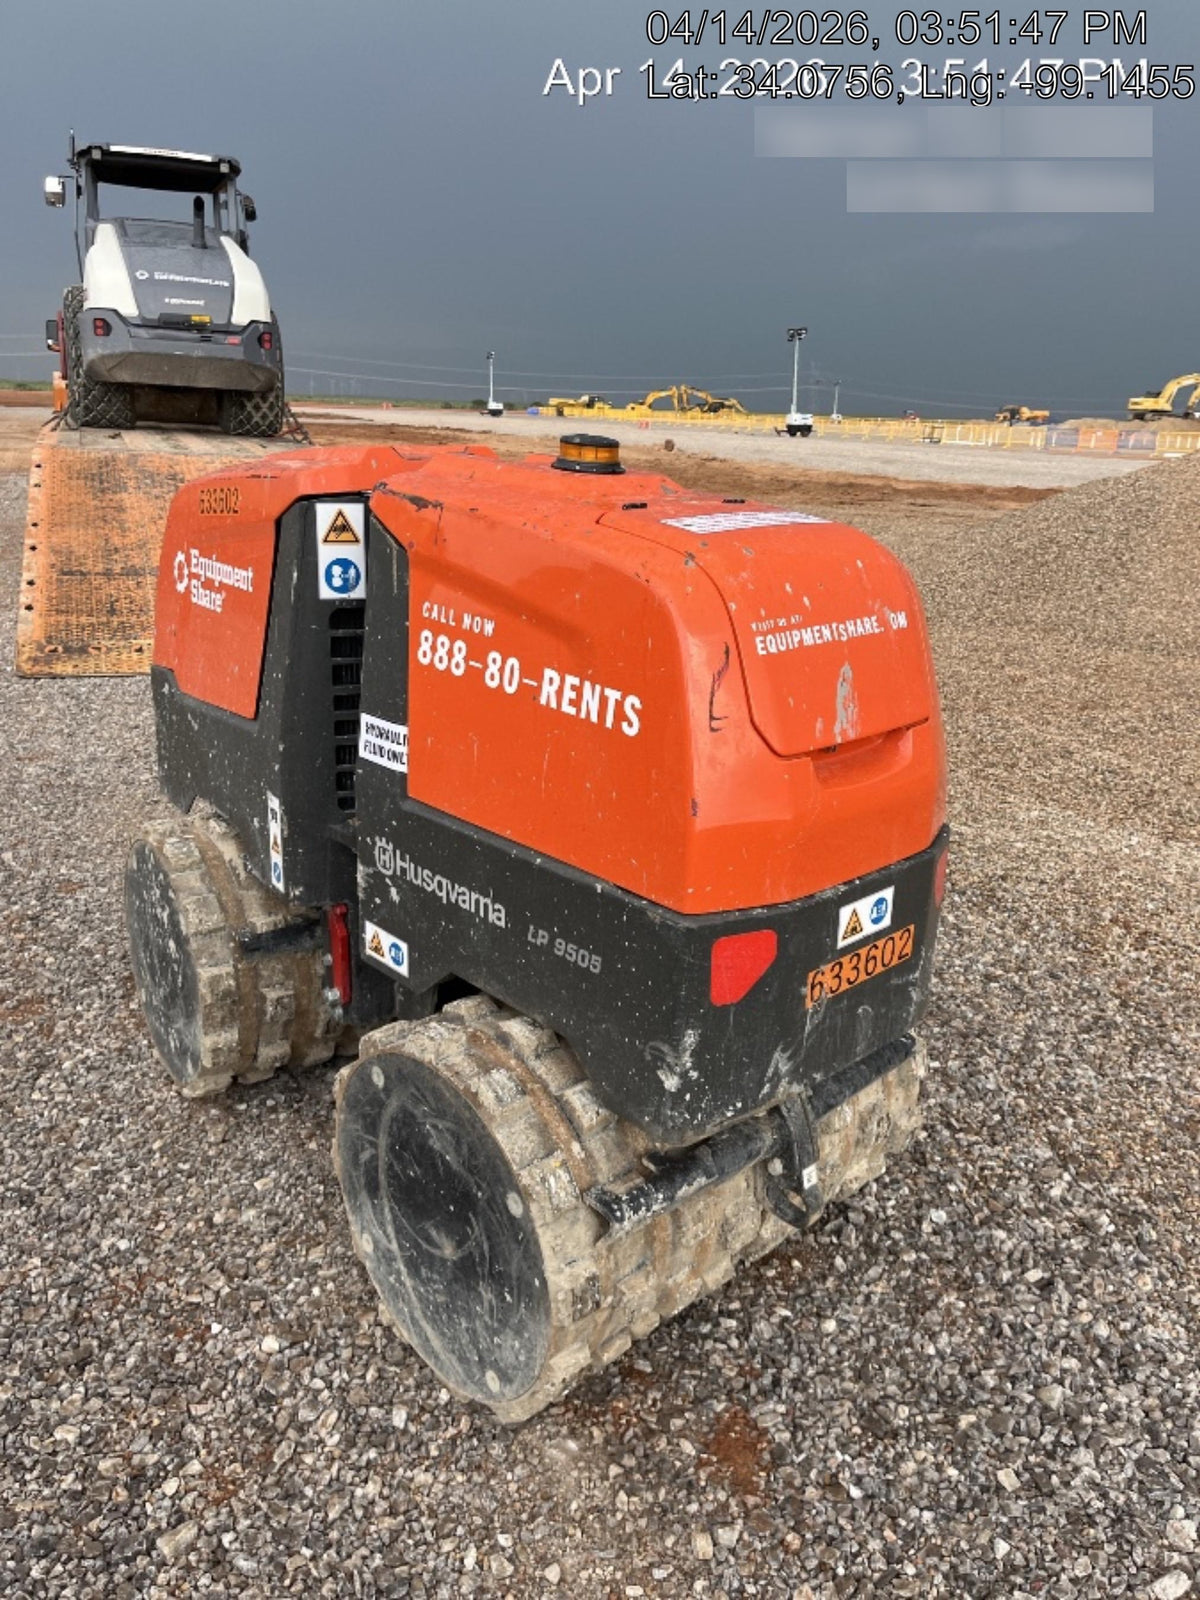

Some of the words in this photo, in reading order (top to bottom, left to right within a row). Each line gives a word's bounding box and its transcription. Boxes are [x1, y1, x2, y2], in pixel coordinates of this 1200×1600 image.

[200, 487, 239, 515] 633602
[190, 548, 254, 593] Equipment
[422, 601, 456, 627] CALL
[461, 612, 495, 637] NOW
[416, 629, 643, 737] 888-80-RENTS
[395, 848, 506, 929] Husqvarna
[527, 924, 549, 947] LP
[554, 939, 602, 974] 9505
[809, 925, 913, 1004] 633602
